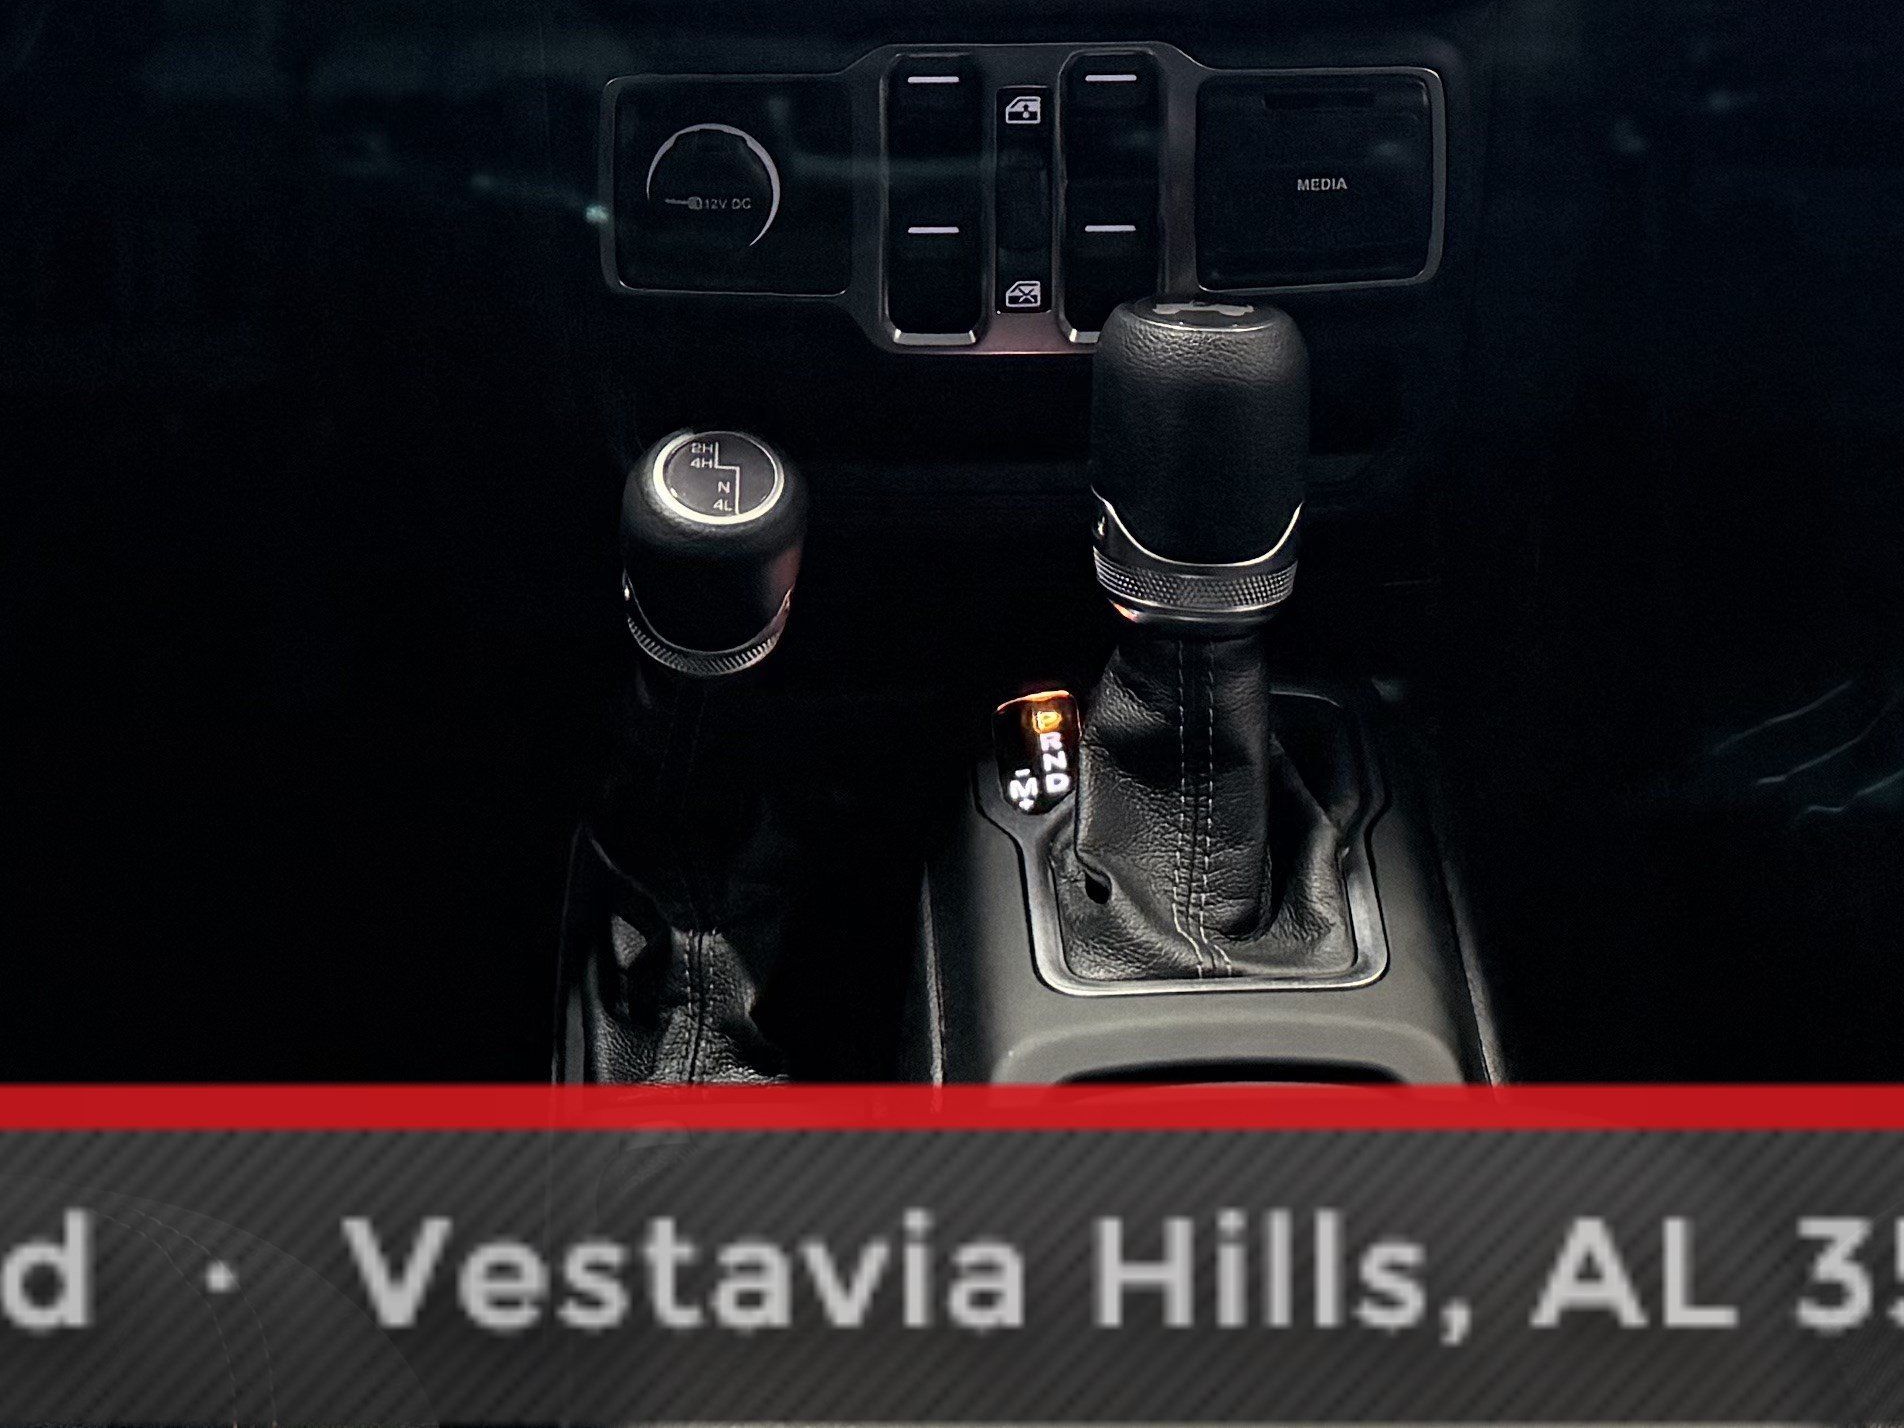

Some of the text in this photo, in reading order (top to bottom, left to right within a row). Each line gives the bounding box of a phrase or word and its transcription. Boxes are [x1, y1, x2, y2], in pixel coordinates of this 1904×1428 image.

[1296, 177, 1348, 192] MEDIA
[705, 197, 752, 210] 12V DC
[689, 457, 714, 469] 4H
[717, 481, 731, 493] N
[712, 499, 733, 512] 4L
[1039, 732, 1064, 752] R
[1042, 750, 1068, 772] N
[1008, 776, 1039, 800] M
[1046, 772, 1071, 794] D
